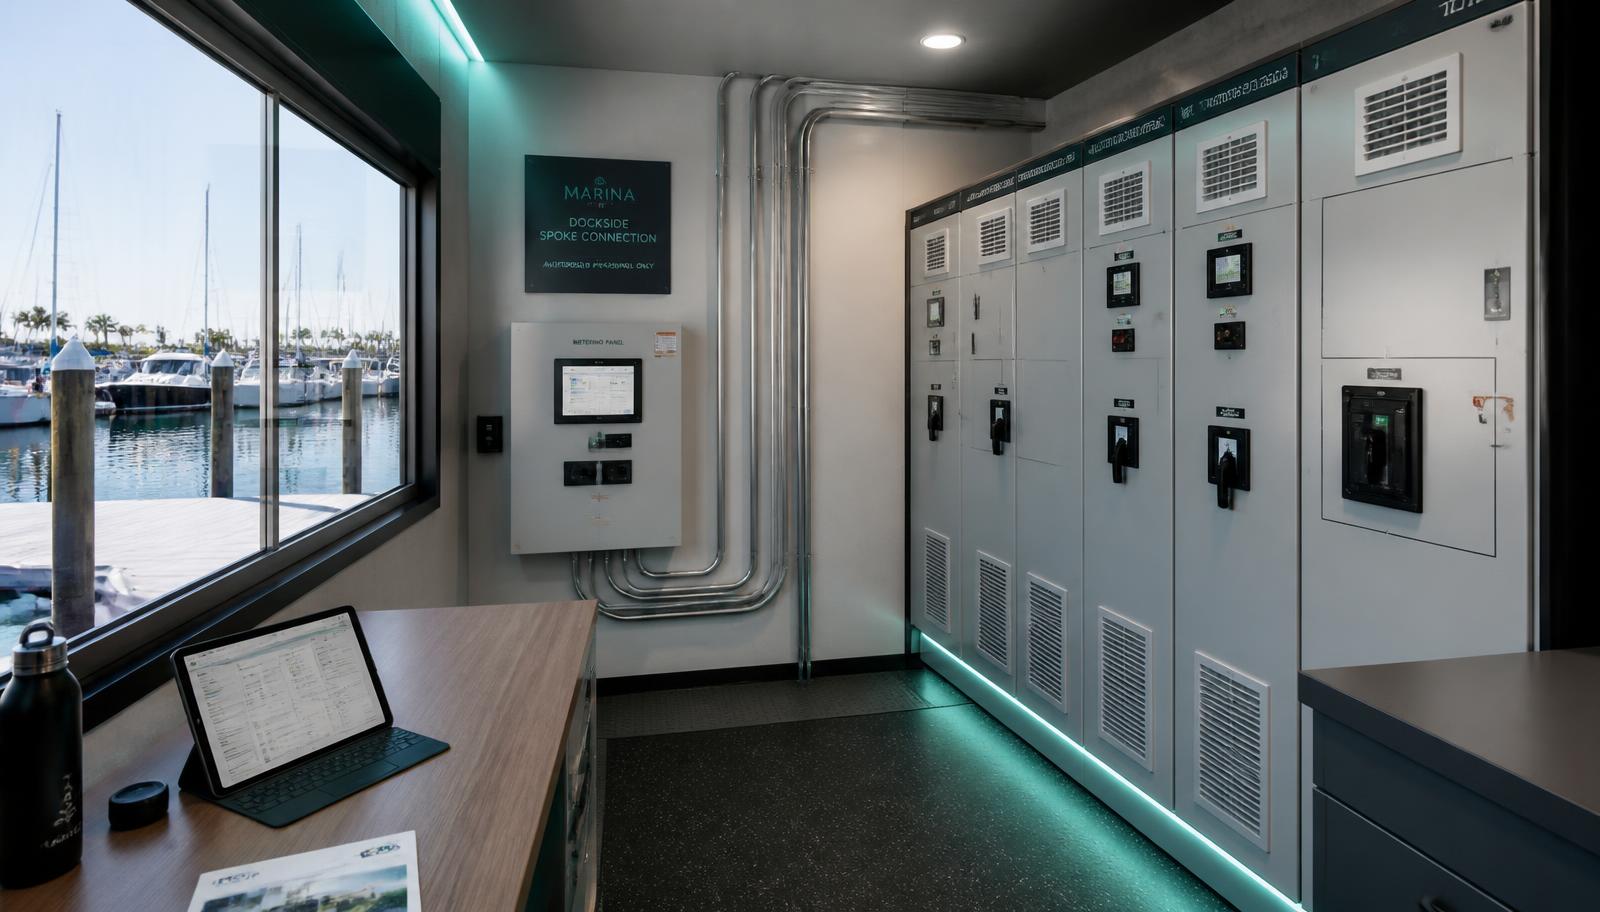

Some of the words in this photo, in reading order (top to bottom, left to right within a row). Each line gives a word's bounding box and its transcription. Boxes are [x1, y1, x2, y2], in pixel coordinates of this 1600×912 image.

[564, 185, 635, 201] MARINA
[569, 217, 629, 229] DOCKSIDE
[539, 231, 577, 241] SPOKE
[582, 232, 657, 243] CONNECTION
